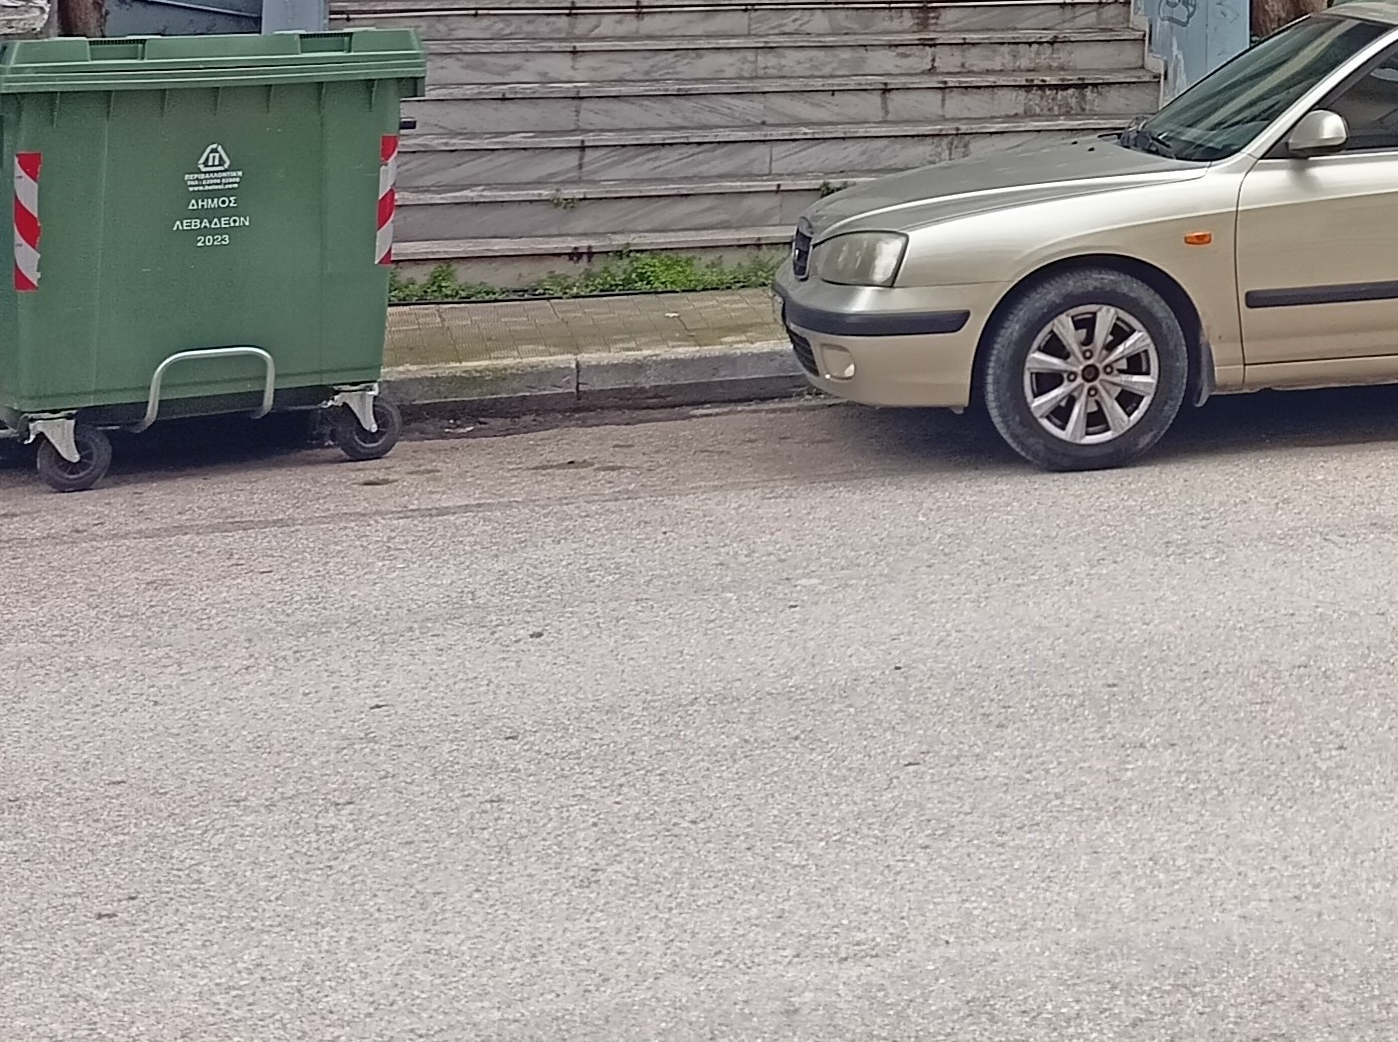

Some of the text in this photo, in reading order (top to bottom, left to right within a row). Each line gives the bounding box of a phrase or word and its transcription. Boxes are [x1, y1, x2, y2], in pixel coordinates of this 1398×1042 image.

[188, 196, 237, 210] ΔΗΜΟΣ
[173, 216, 250, 231] ΛΕΒΑΔΕΩΝ
[196, 234, 230, 247] 2023
